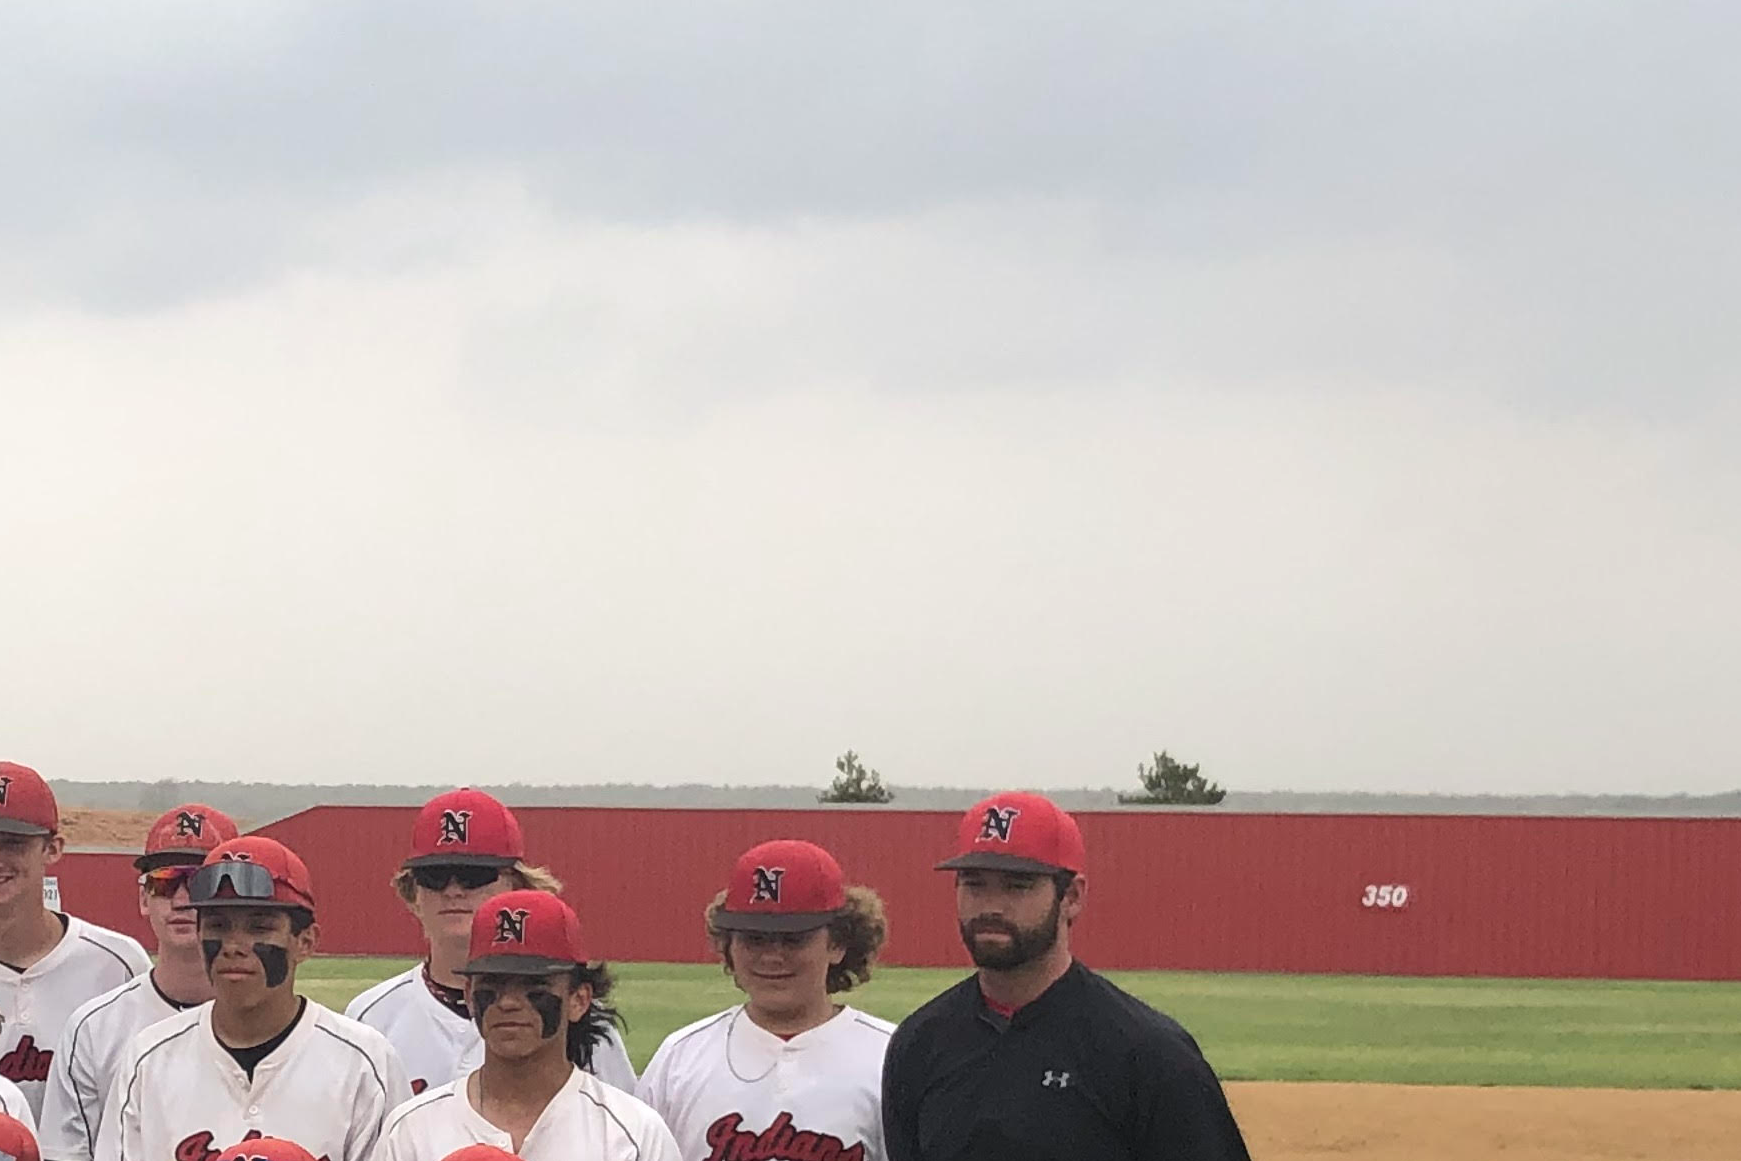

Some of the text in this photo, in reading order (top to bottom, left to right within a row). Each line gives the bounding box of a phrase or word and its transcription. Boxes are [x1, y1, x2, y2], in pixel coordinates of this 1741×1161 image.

[175, 811, 207, 838] N
[436, 809, 472, 846] N
[974, 805, 1021, 843] N
[750, 866, 785, 904] N
[1361, 884, 1408, 907] 350
[492, 908, 530, 946] N
